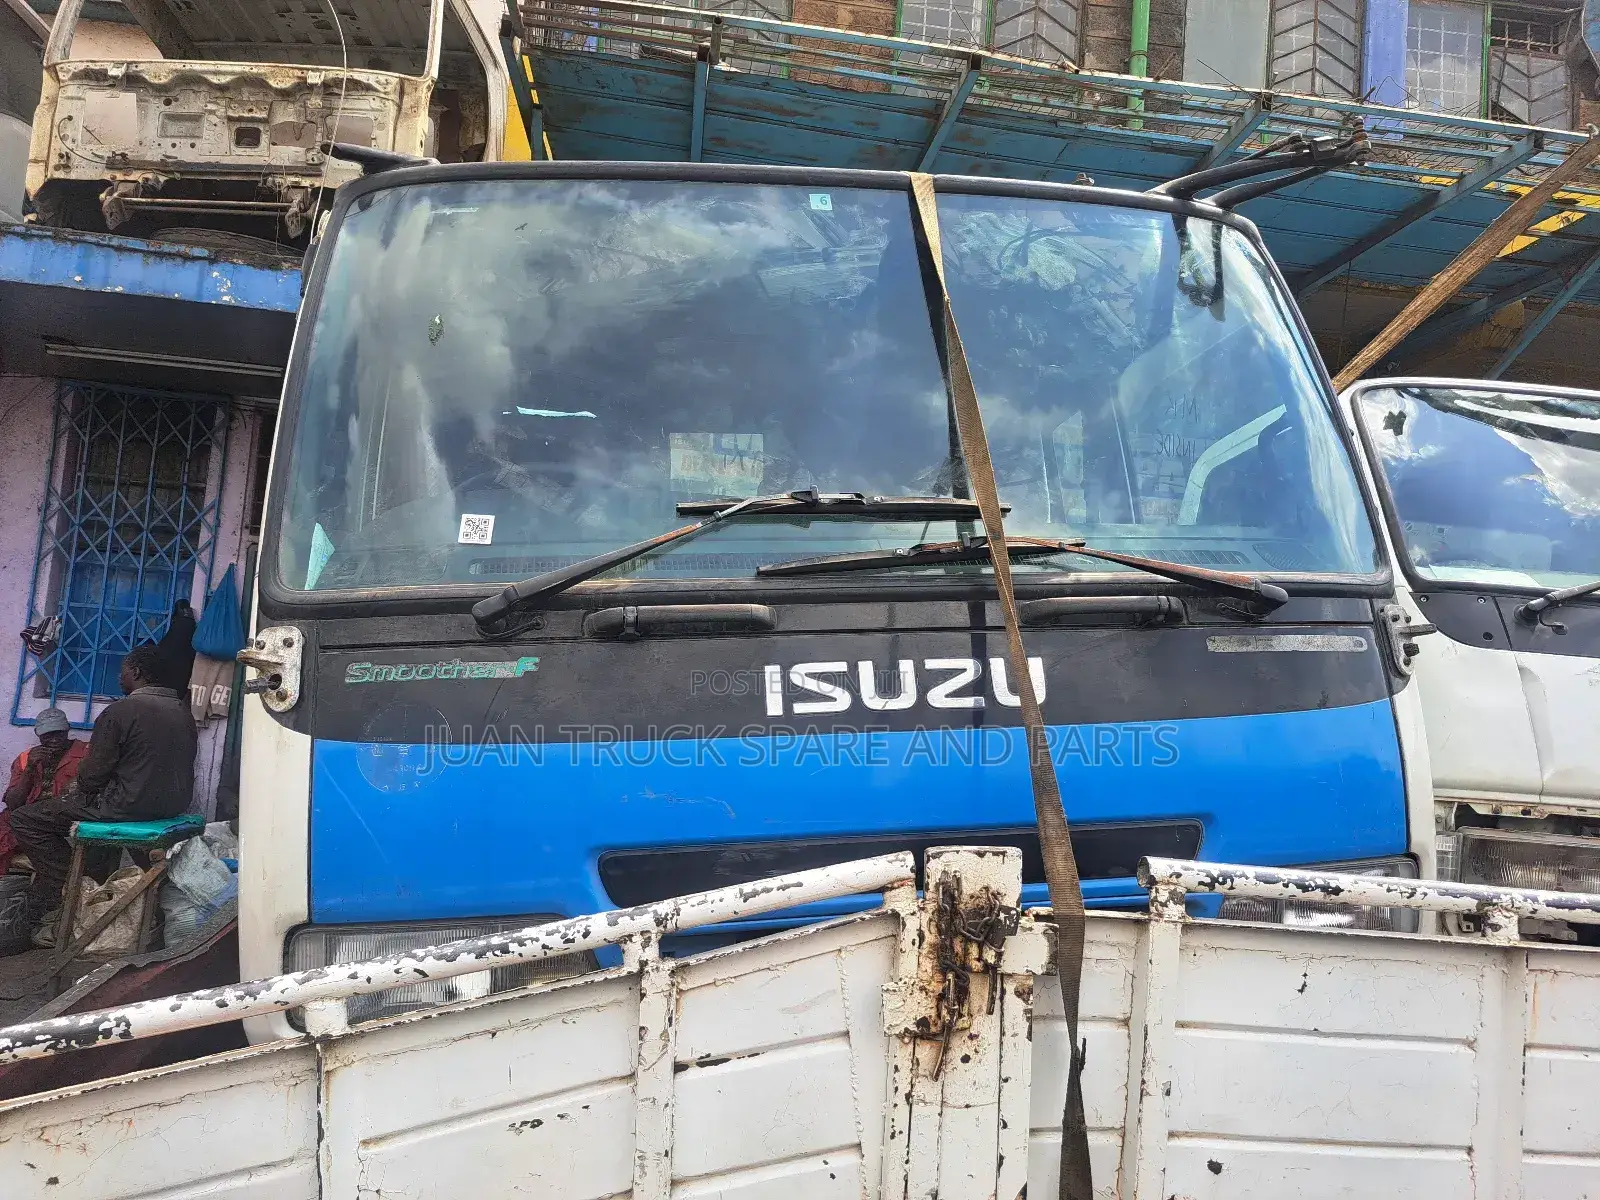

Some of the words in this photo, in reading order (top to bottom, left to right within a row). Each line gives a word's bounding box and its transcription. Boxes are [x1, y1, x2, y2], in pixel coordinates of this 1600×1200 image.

[820, 196, 828, 206] 6
[191, 683, 207, 707] TO
[764, 656, 1047, 717] ISUZU
